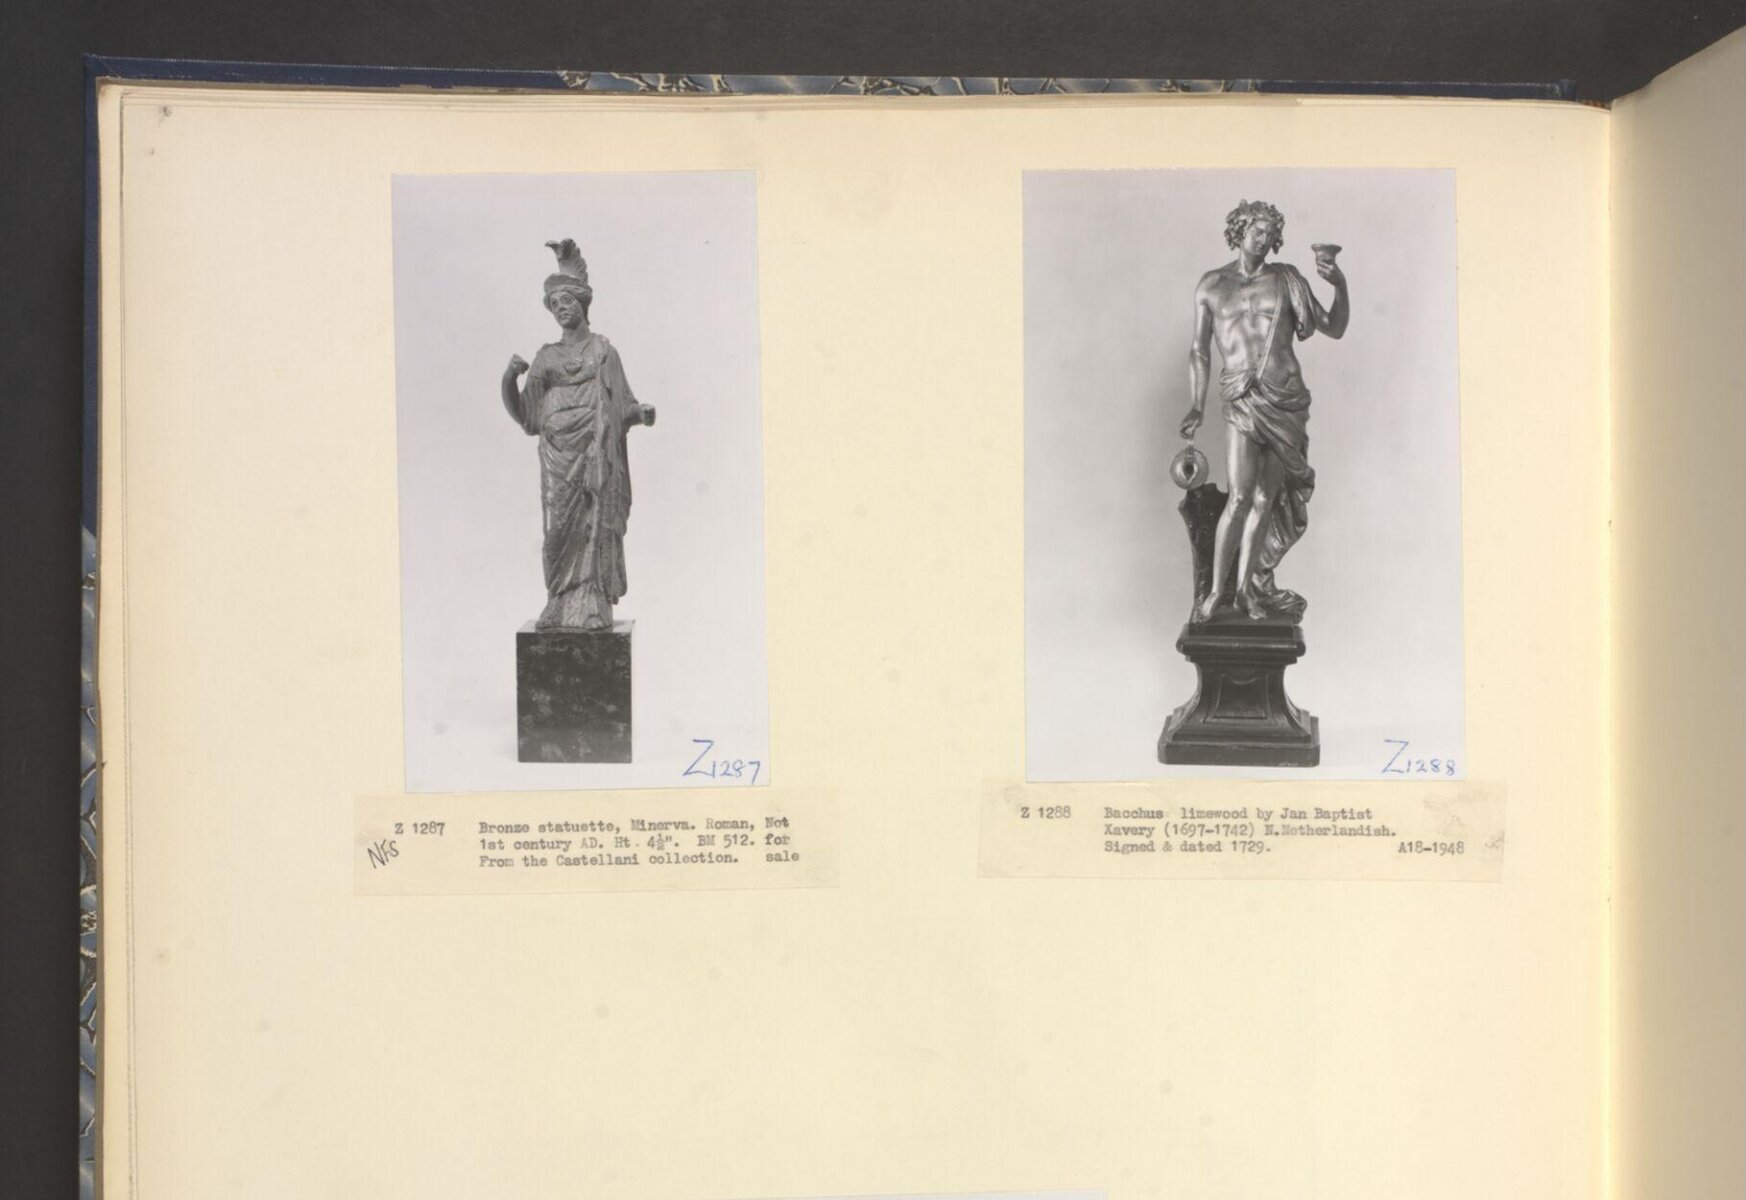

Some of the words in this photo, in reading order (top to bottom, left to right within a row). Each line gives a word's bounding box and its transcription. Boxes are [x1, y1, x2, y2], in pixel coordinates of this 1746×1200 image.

[682, 739, 762, 786] Z1287
[1380, 739, 1457, 775] Z1288
[1020, 807, 1030, 819] Z
[1037, 806, 1072, 819] 1288
[1103, 807, 1164, 820] Bacchus
[1180, 807, 1248, 820] limewood
[1257, 808, 1273, 822] by
[1280, 808, 1308, 820] Jan
[1314, 807, 1373, 822] Baptist
[394, 824, 405, 835] Z
[412, 823, 446, 837] 1287
[478, 822, 531, 834] Bronze
[537, 820, 621, 834] statuette,
[631, 819, 696, 831] Minerva.
[705, 818, 755, 831] Roman,
[764, 816, 790, 829] Not
[1104, 823, 1155, 838] Xavery
[1164, 822, 1255, 838] (1697-1742)
[479, 838, 505, 850] 1st
[513, 839, 573, 852] century
[580, 837, 604, 849] AD.
[697, 835, 716, 847] BM
[723, 834, 755, 848] 512.
[764, 833, 791, 846] for
[1104, 841, 1156, 855] Signed
[1162, 841, 1173, 853] &
[1180, 840, 1223, 852] dated
[1231, 840, 1272, 854] 1729.
[1398, 841, 1465, 856] A18-1948
[478, 856, 514, 868] From
[522, 855, 549, 867] the
[556, 853, 640, 866] Castellani
[649, 852, 739, 865] collection.
[765, 850, 800, 863] sale
